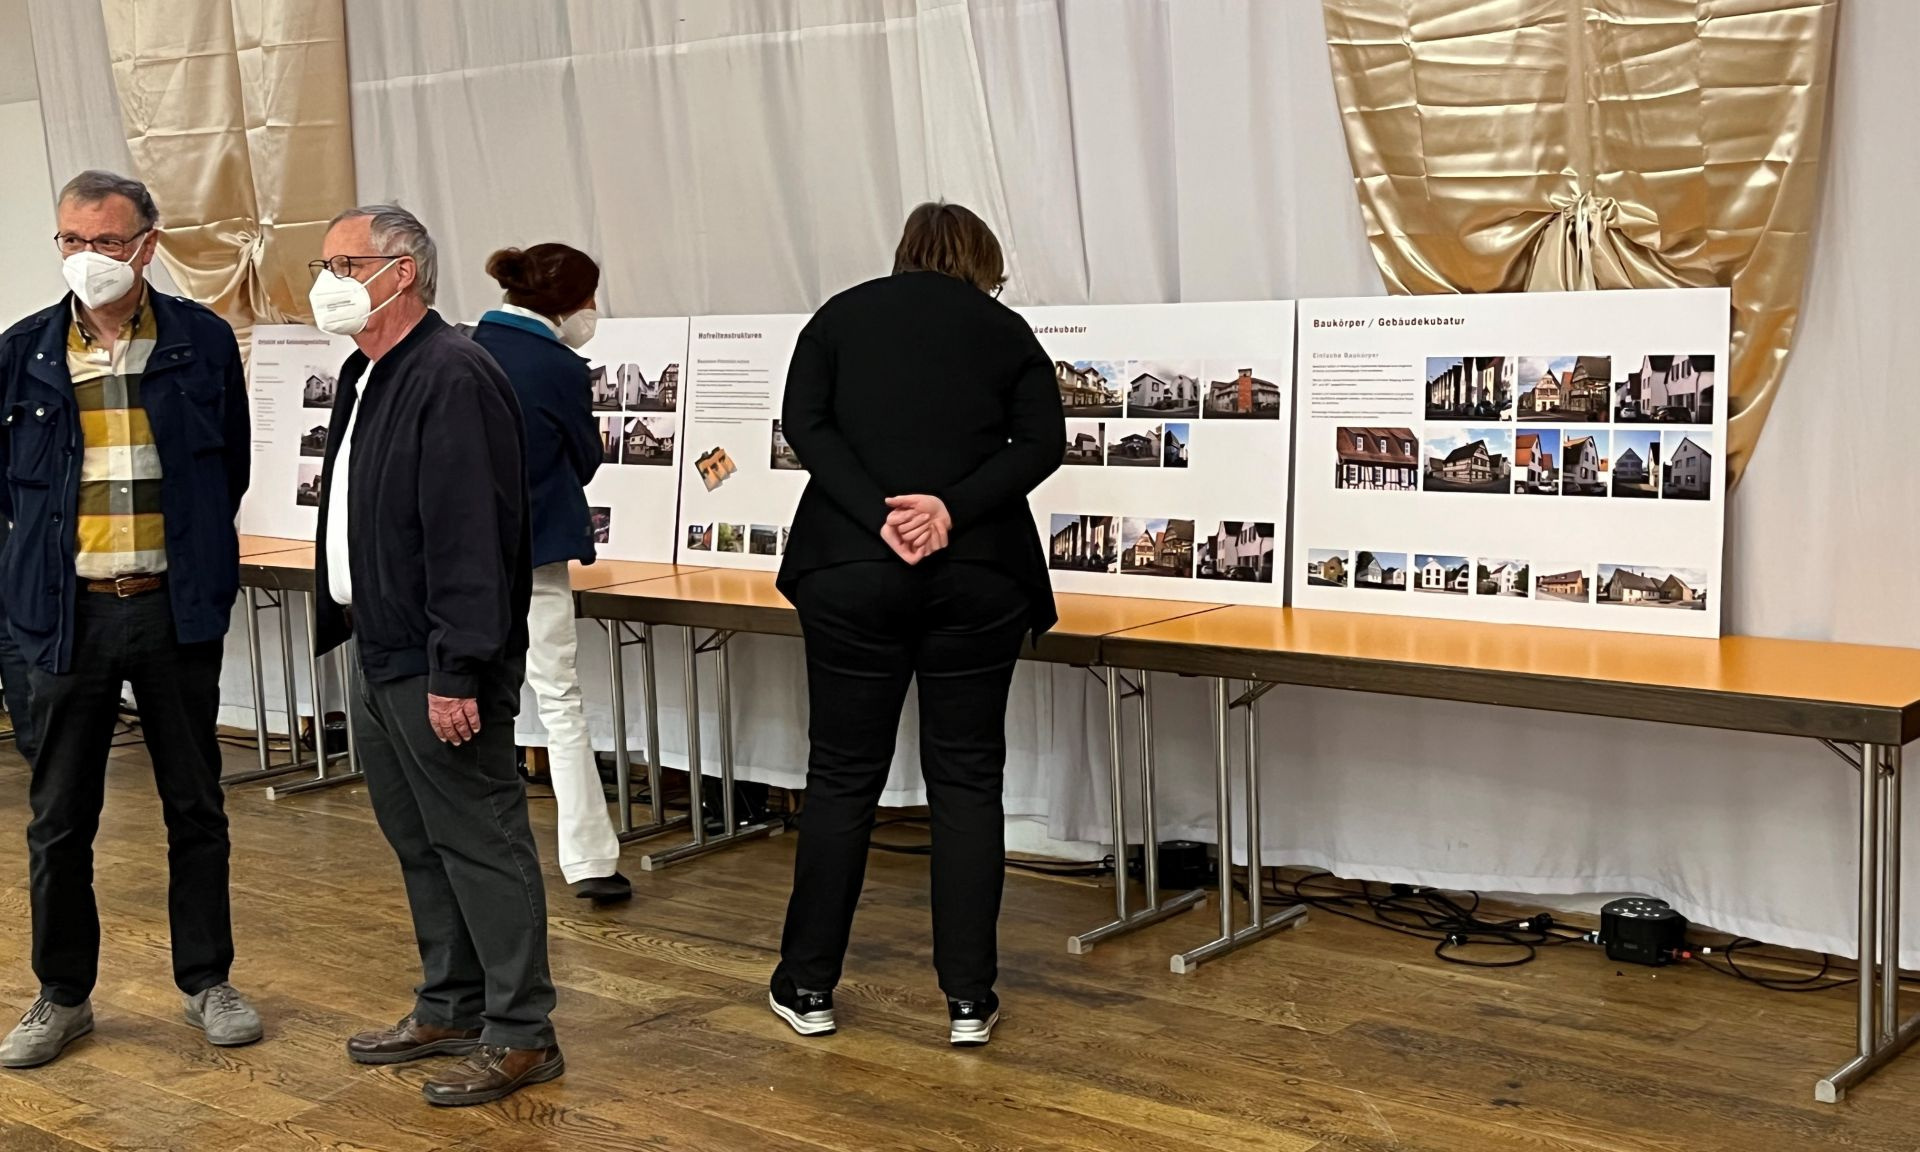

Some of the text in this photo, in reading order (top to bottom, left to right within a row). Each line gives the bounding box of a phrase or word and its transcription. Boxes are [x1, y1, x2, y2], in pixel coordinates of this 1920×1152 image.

[1313, 318, 1365, 328] Baukörper
[1378, 317, 1465, 327] Gebäudekubatur
[1033, 325, 1087, 334] äudekubatur
